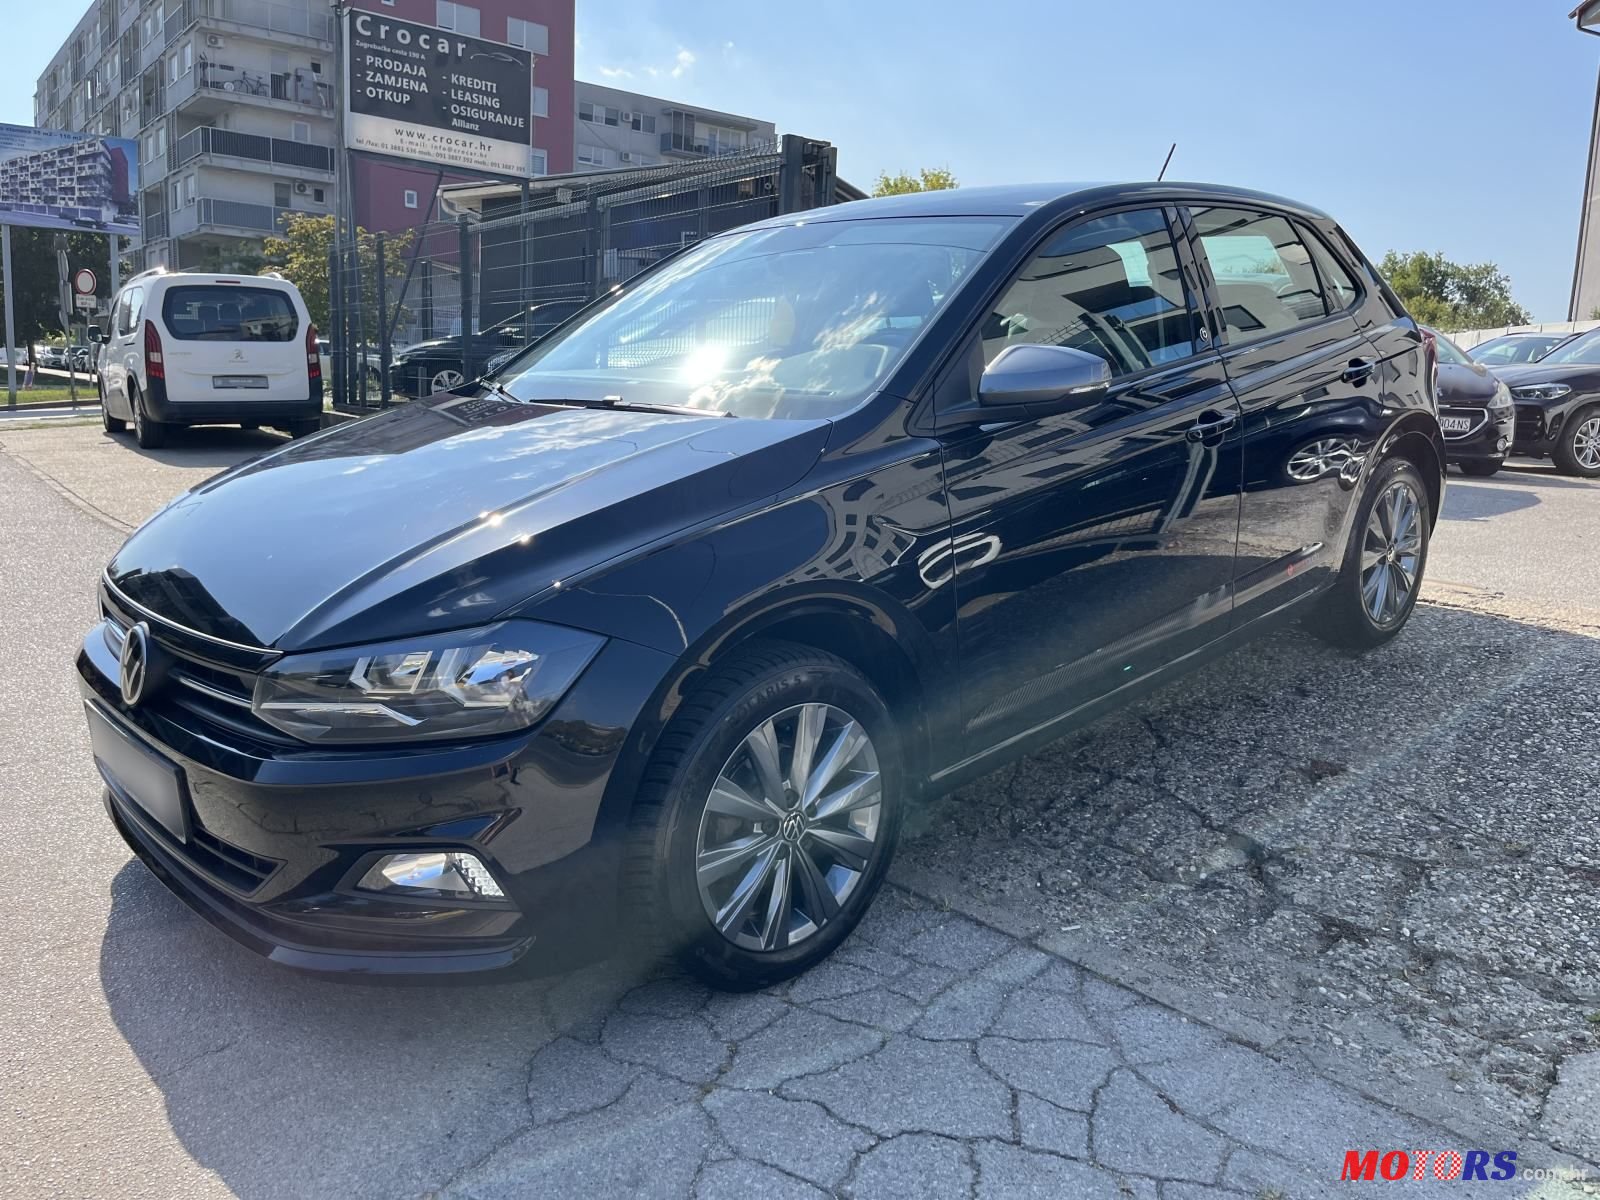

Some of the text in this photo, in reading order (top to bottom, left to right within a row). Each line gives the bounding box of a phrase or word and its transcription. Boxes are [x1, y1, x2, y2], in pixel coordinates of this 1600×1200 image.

[356, 15, 466, 57] Crocar
[366, 55, 427, 78] PRODAJA
[366, 70, 429, 93] ZAMJENA
[451, 73, 497, 93] KREDITI
[366, 86, 411, 104] OTKUP
[451, 88, 500, 109] LEASING
[450, 104, 525, 128] OSIGURANJE
[451, 118, 480, 131] Allianz
[395, 128, 492, 152] www.crocar.hr
